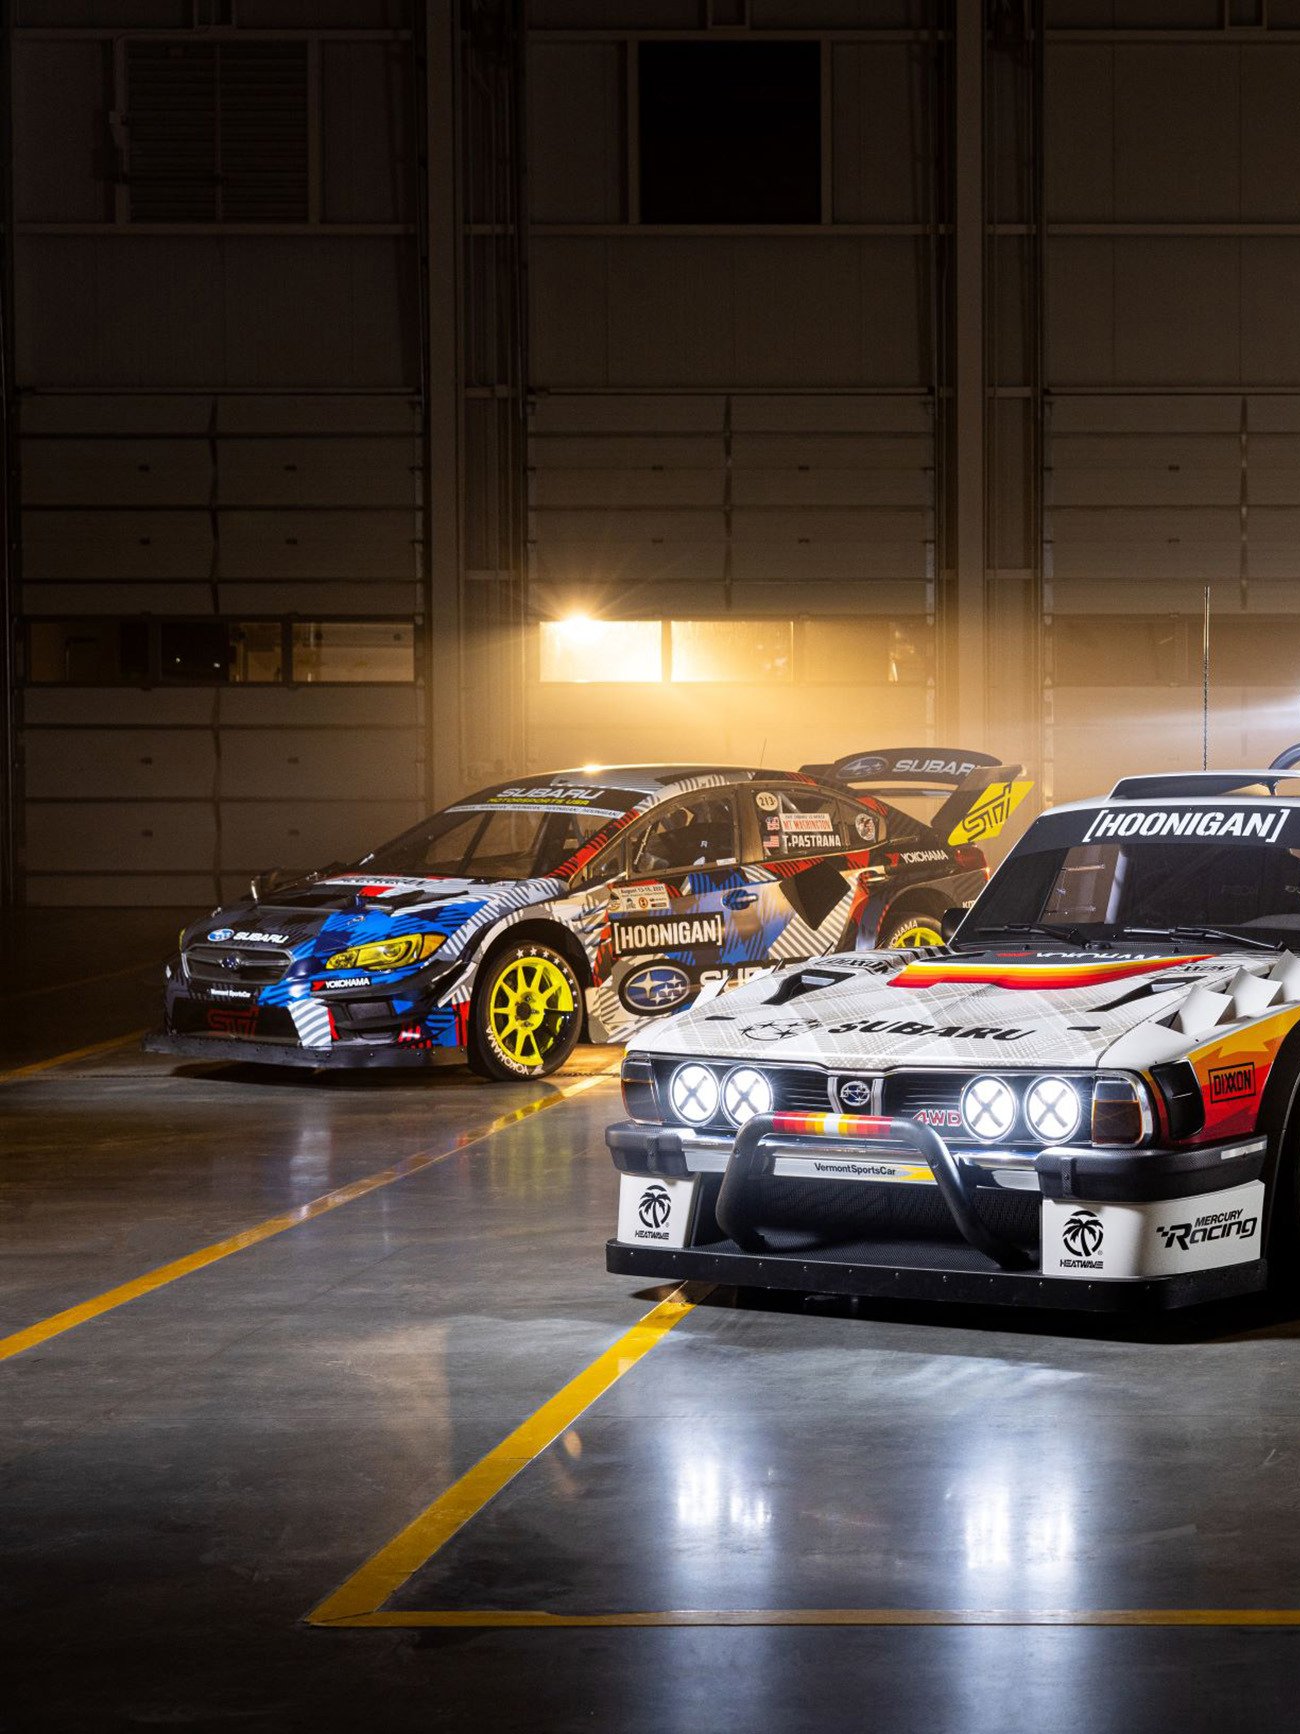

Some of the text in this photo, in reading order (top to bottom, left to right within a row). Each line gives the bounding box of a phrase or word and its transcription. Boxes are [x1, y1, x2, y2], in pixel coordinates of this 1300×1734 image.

[892, 760, 976, 776] SUBAR
[497, 788, 605, 799] SUBARU
[1082, 809, 1290, 843] [HOONIGAN]
[900, 850, 949, 864] YOKOHAMA
[233, 932, 289, 943] SUBARU
[613, 914, 723, 954] [HOONIGAN]
[325, 977, 370, 988] YOKOHAMA
[828, 1020, 1036, 1041] SUBARU
[485, 1025, 530, 1075] YOKOHAMA
[1212, 1069, 1251, 1097] DIXXON
[912, 1109, 963, 1127] 4WD
[1194, 1208, 1244, 1228] MERCURY
[634, 1230, 670, 1240] HEATWAVE
[1160, 1217, 1258, 1250] Racing
[1059, 1259, 1104, 1270] HEATWAVE
